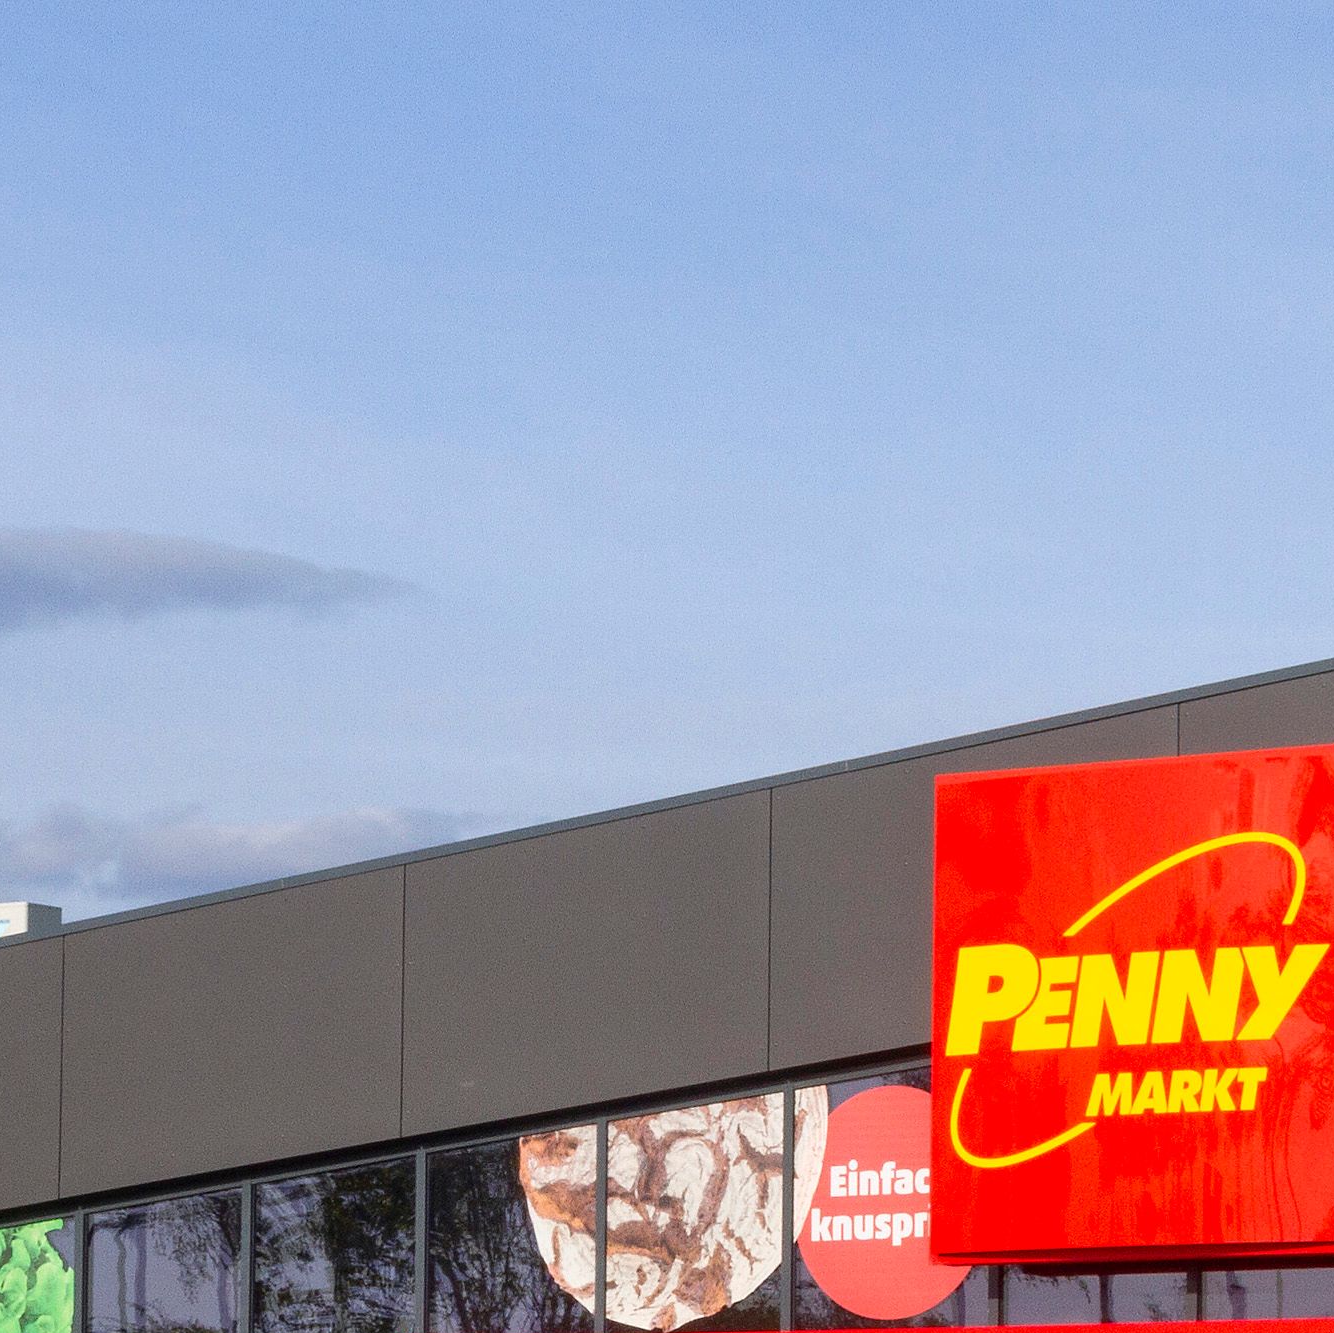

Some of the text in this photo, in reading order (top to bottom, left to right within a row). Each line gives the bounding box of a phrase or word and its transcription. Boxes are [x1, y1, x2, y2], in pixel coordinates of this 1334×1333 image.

[944, 943, 1332, 1057] PENNY
[1085, 1066, 1268, 1117] MARKT
[830, 1158, 930, 1197] Einfac
[810, 1203, 930, 1247] knuspr
